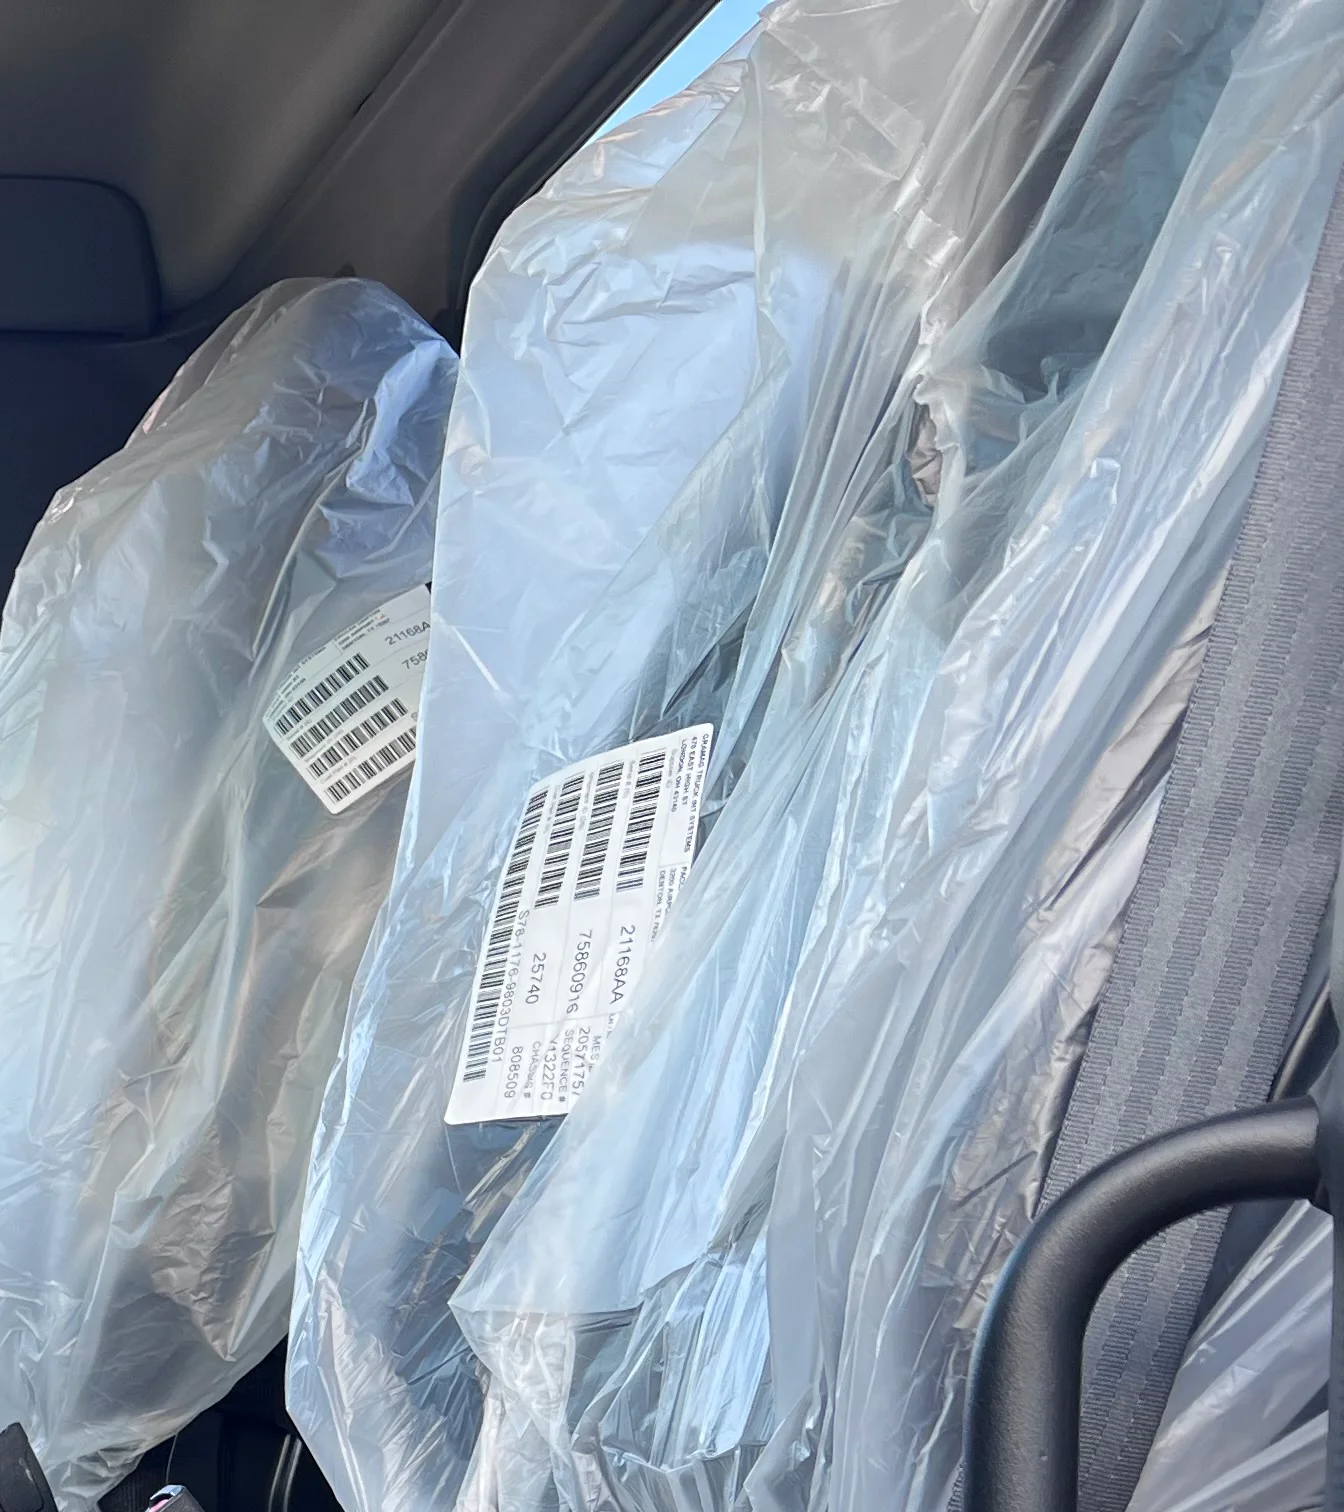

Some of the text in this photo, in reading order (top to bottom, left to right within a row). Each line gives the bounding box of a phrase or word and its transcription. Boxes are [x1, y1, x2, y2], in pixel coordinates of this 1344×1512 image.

[385, 621, 430, 646] 21168A
[687, 751, 696, 775] EAST
[694, 771, 704, 800] TRUCK
[491, 908, 530, 1063] S78-1176-9803DTB01
[525, 952, 547, 1005] 25740
[566, 929, 593, 1014] 75860916
[609, 924, 636, 1004] 21168AA
[503, 1045, 524, 1100] 808509
[558, 1028, 575, 1094] SEQUENCE
